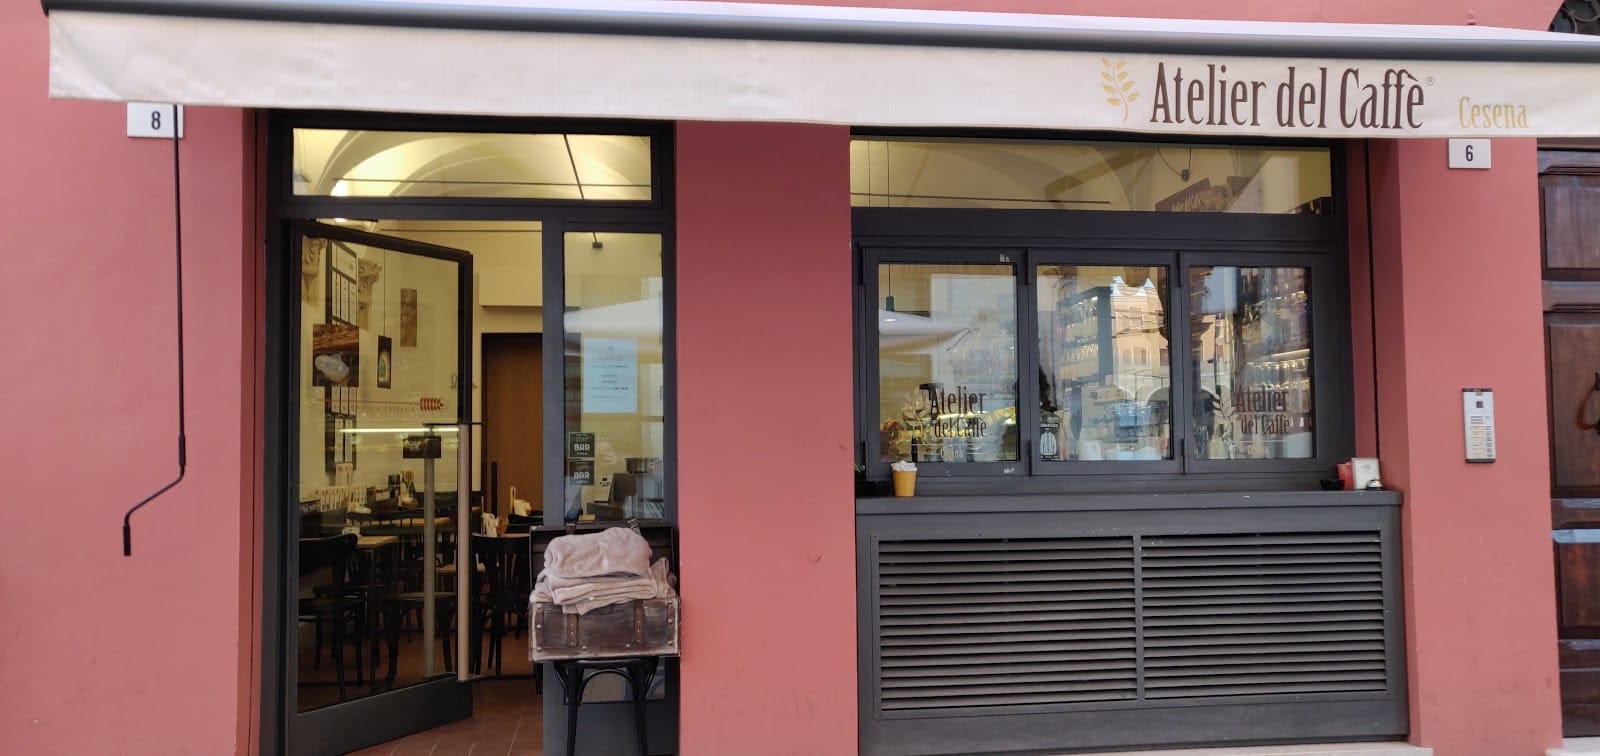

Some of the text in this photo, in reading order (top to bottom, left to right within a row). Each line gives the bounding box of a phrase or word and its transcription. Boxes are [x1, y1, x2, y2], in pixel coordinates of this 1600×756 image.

[1149, 62, 1425, 129] Atelier del Caffè
[151, 110, 161, 130] 8
[1459, 97, 1530, 129] Cesena
[1464, 144, 1475, 162] 6
[930, 386, 986, 414] Atelier
[1236, 384, 1289, 412] Atelier
[934, 417, 954, 438] del
[1241, 414, 1259, 435] del
[573, 443, 591, 452] BAR
[573, 471, 590, 480] BAR
